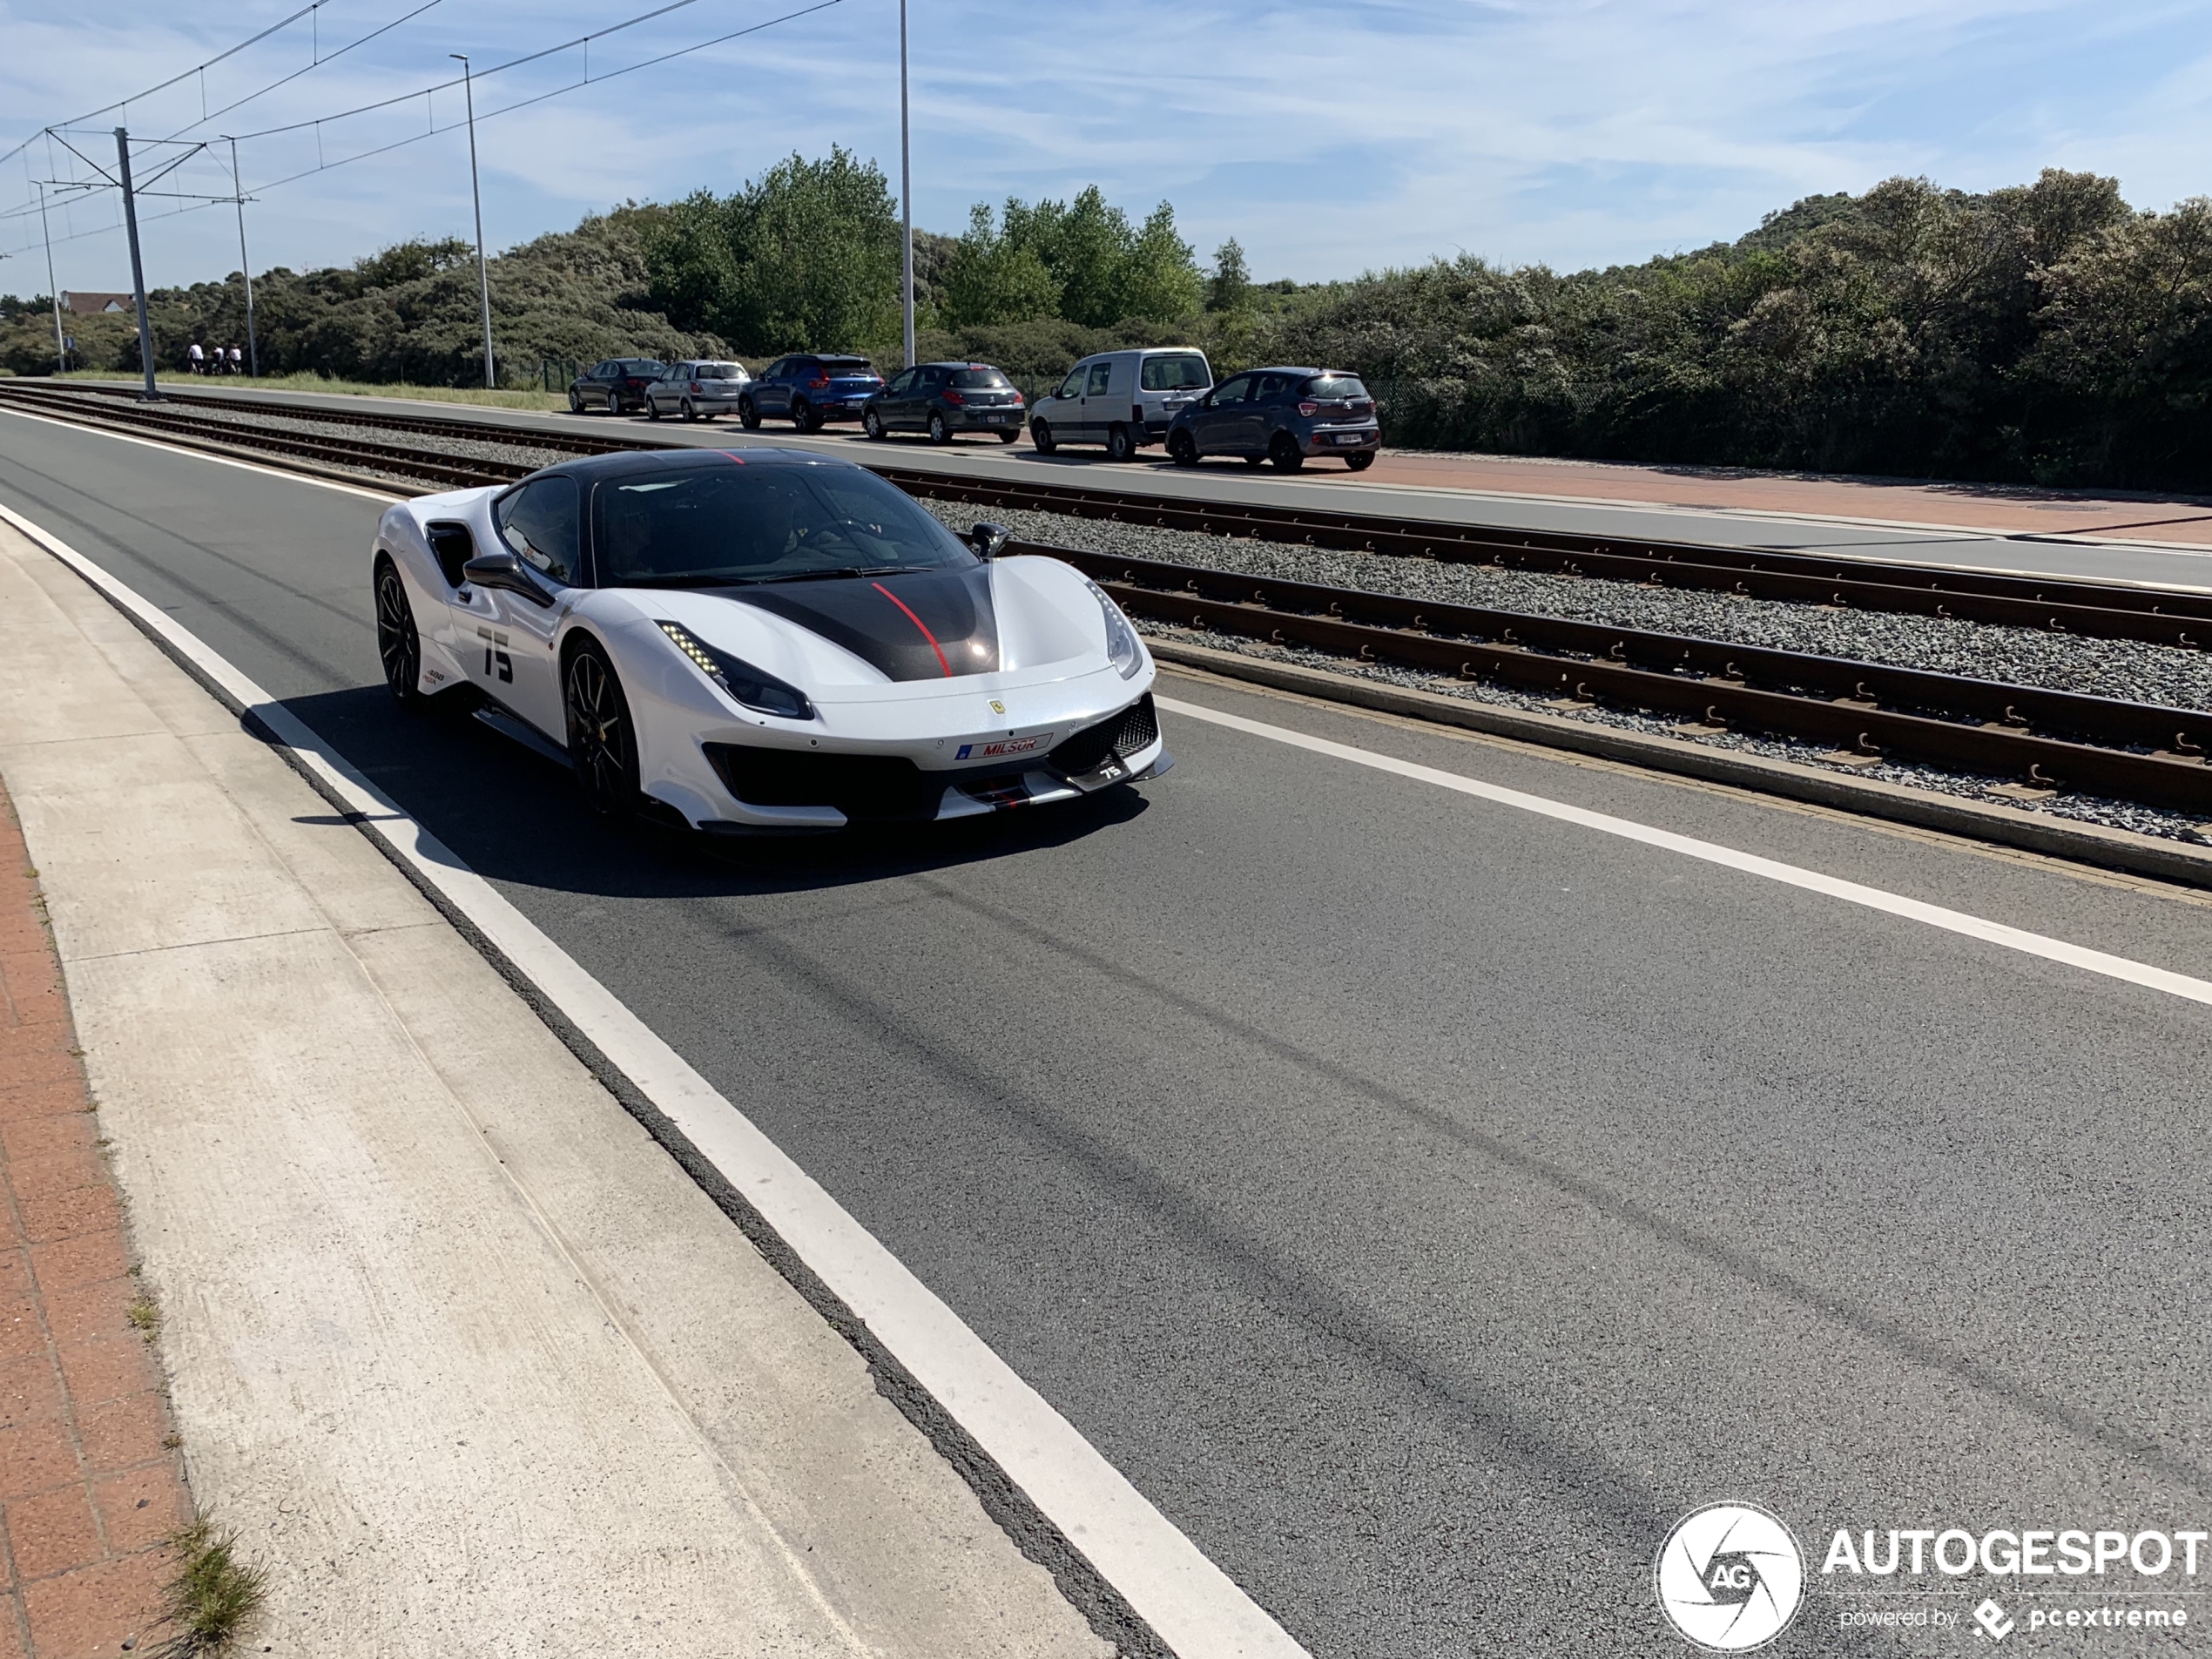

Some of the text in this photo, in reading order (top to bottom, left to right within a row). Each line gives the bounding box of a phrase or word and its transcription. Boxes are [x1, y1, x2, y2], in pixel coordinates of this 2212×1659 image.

[476, 625, 514, 685] 75
[428, 669, 445, 682] 488
[983, 738, 1037, 756] MILSOR
[1099, 765, 1122, 779] 75
